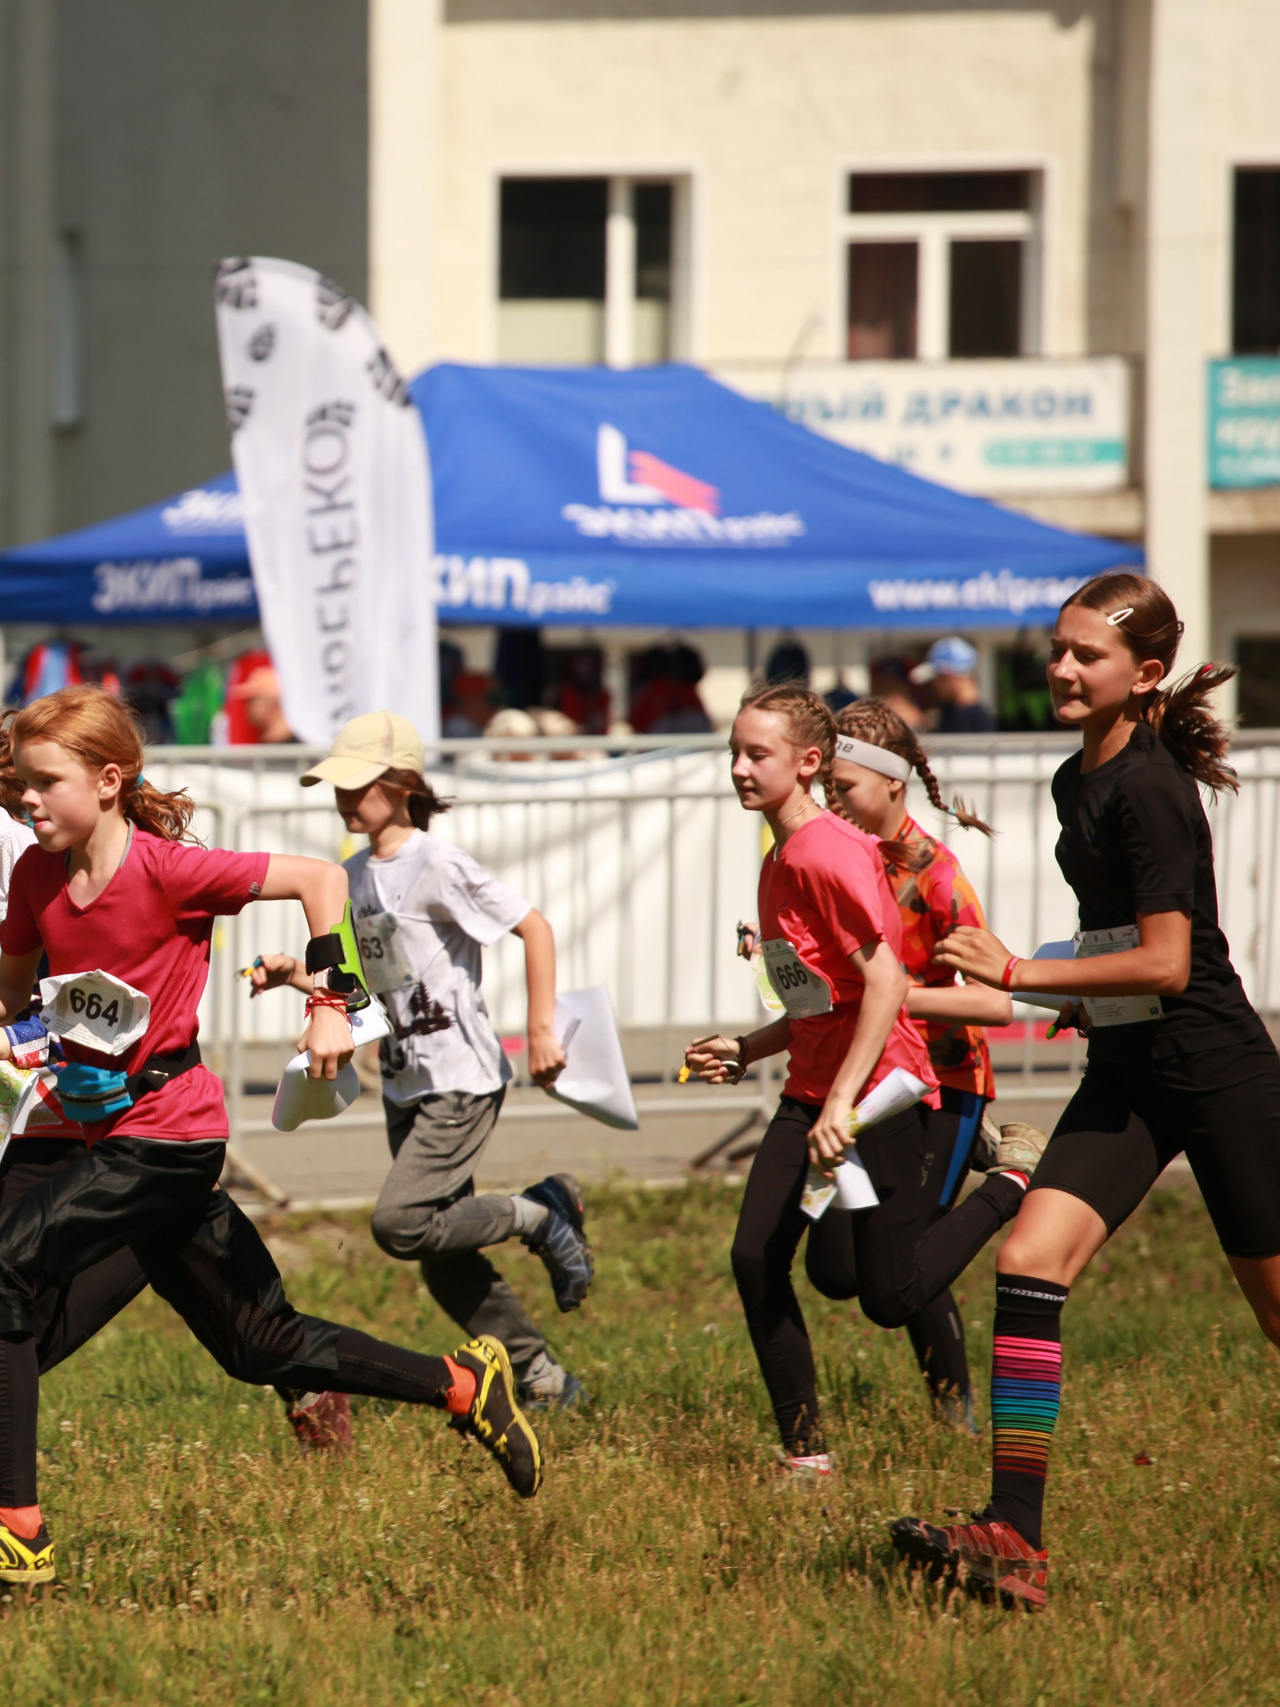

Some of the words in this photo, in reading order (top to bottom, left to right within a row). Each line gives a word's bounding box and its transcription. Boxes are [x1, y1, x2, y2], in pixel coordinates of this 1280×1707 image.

[901, 389, 1091, 427] ДРАКОН
[776, 961, 808, 990] 666
[69, 987, 119, 1028] 664
